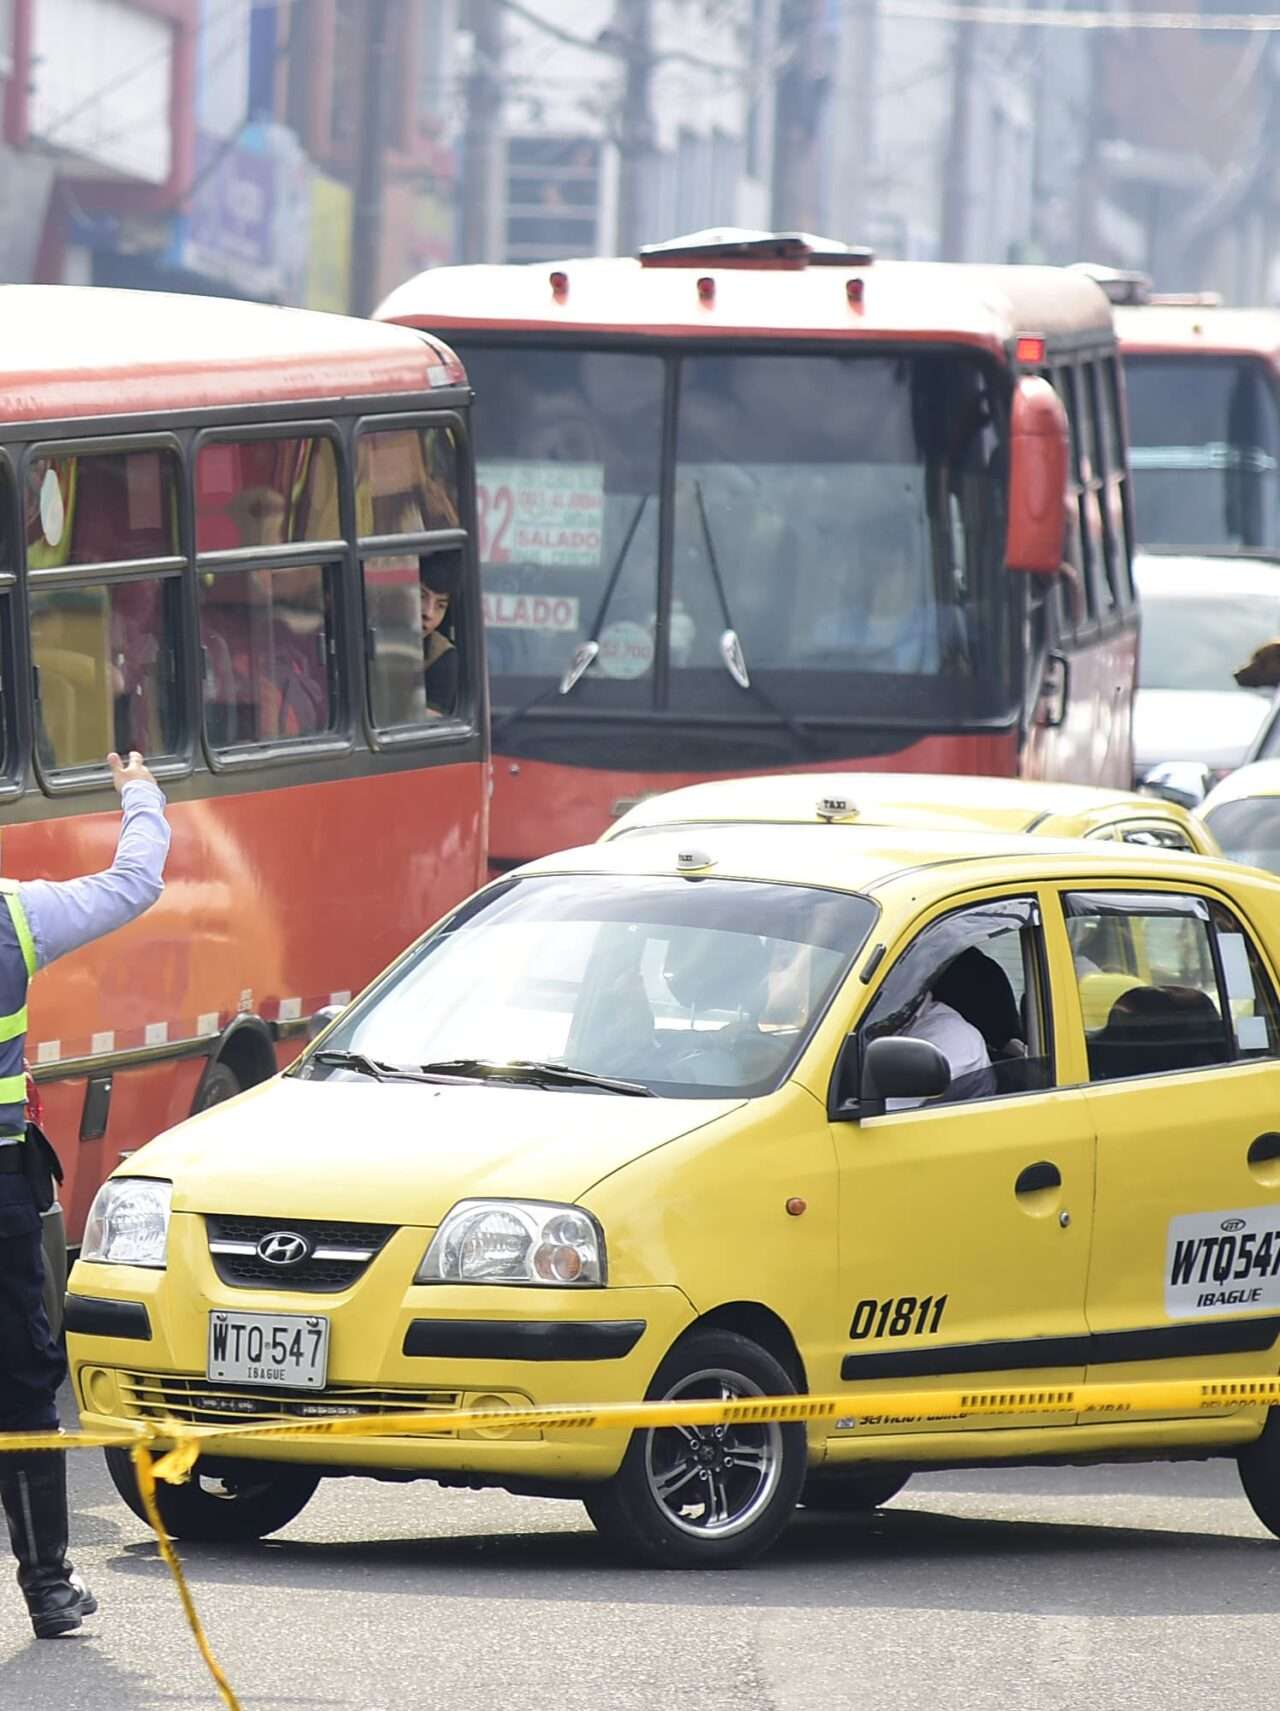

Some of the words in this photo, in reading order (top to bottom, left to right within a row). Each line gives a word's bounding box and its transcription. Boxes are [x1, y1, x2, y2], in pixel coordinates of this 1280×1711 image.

[823, 798, 847, 811] TAXI
[1196, 1287, 1264, 1308] IBAGUE
[848, 1294, 949, 1340] 01811
[247, 1366, 287, 1381] IBAGUE
